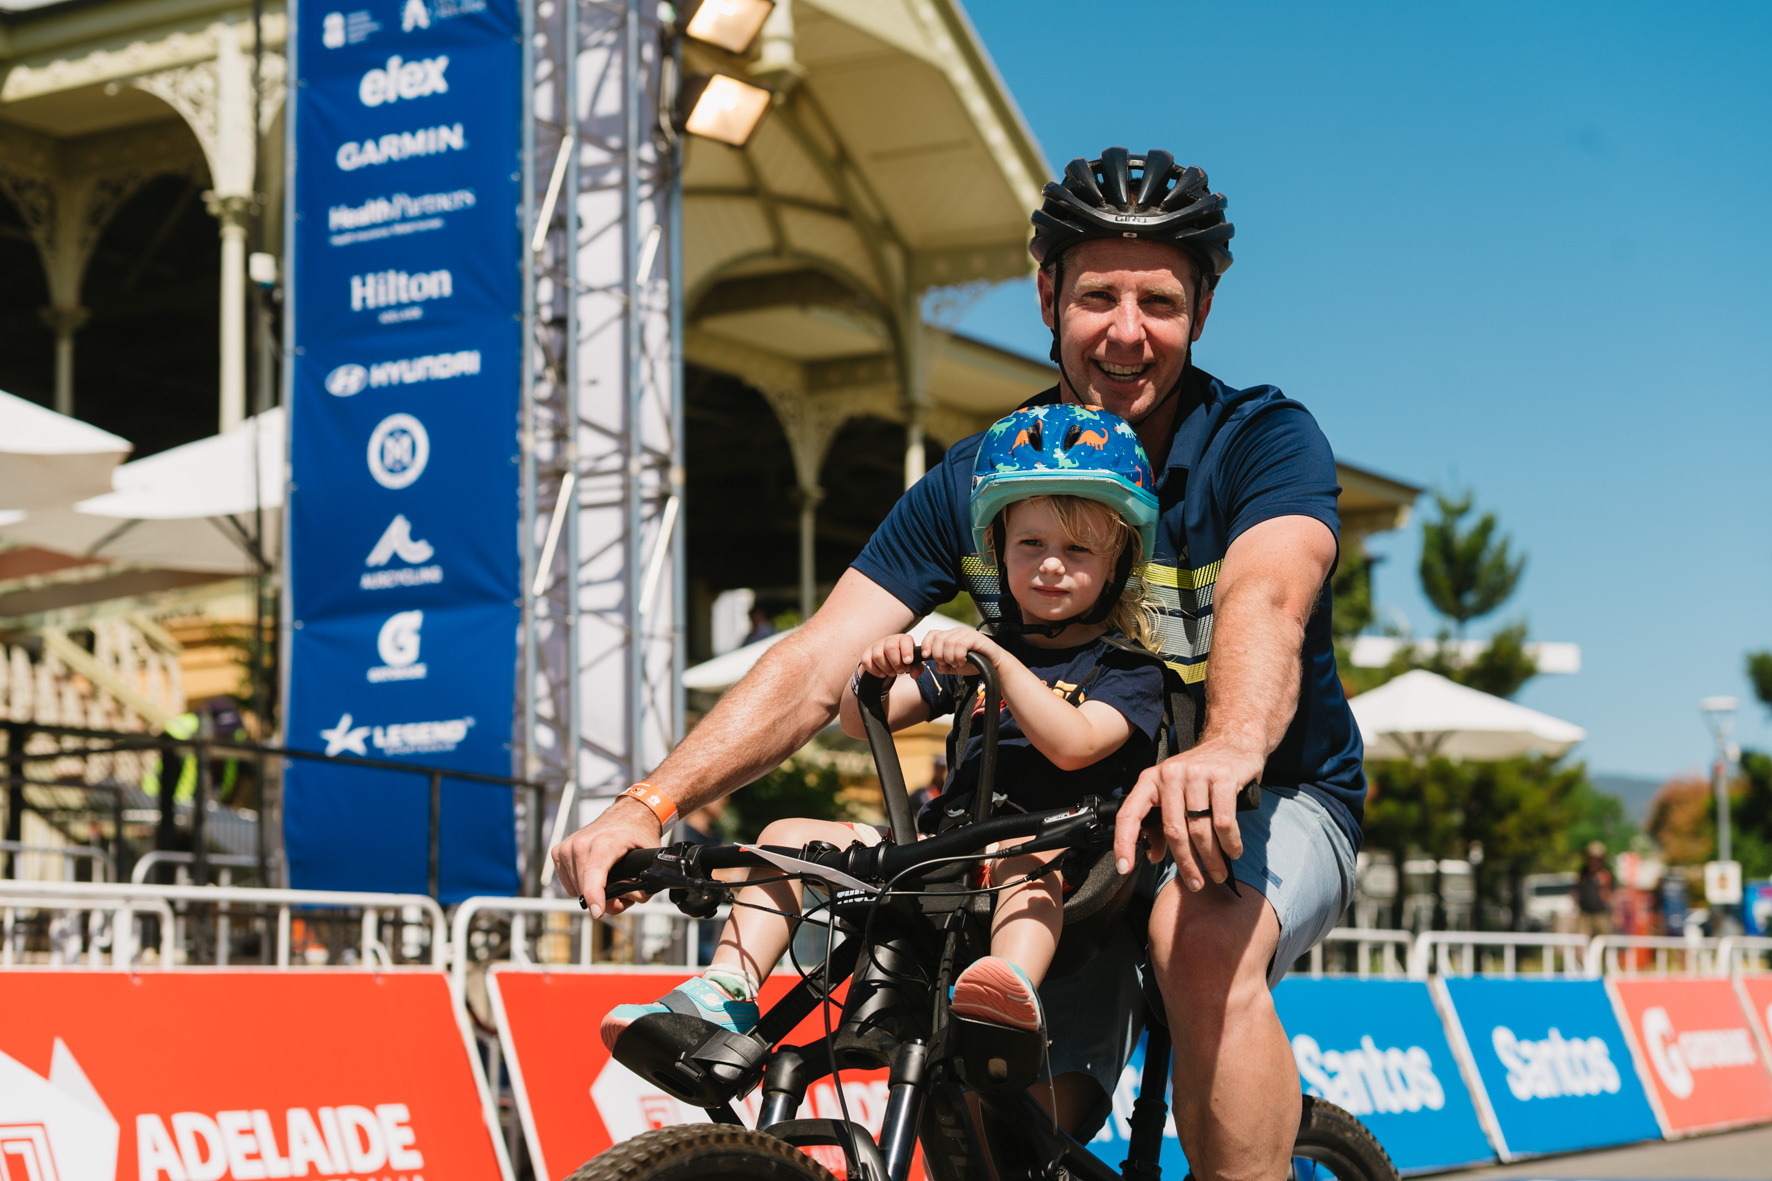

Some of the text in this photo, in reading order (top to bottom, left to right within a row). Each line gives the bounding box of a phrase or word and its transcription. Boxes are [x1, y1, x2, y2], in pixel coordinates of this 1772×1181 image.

[336, 122, 465, 171] GARMIN
[351, 269, 453, 312] Hilton
[368, 349, 482, 388] HYUNDAI
[372, 719, 467, 749] LEGEND
[1291, 1033, 1446, 1117] Santos
[1491, 1025, 1622, 1101] Santos
[136, 1103, 425, 1181] ADELAIDE
